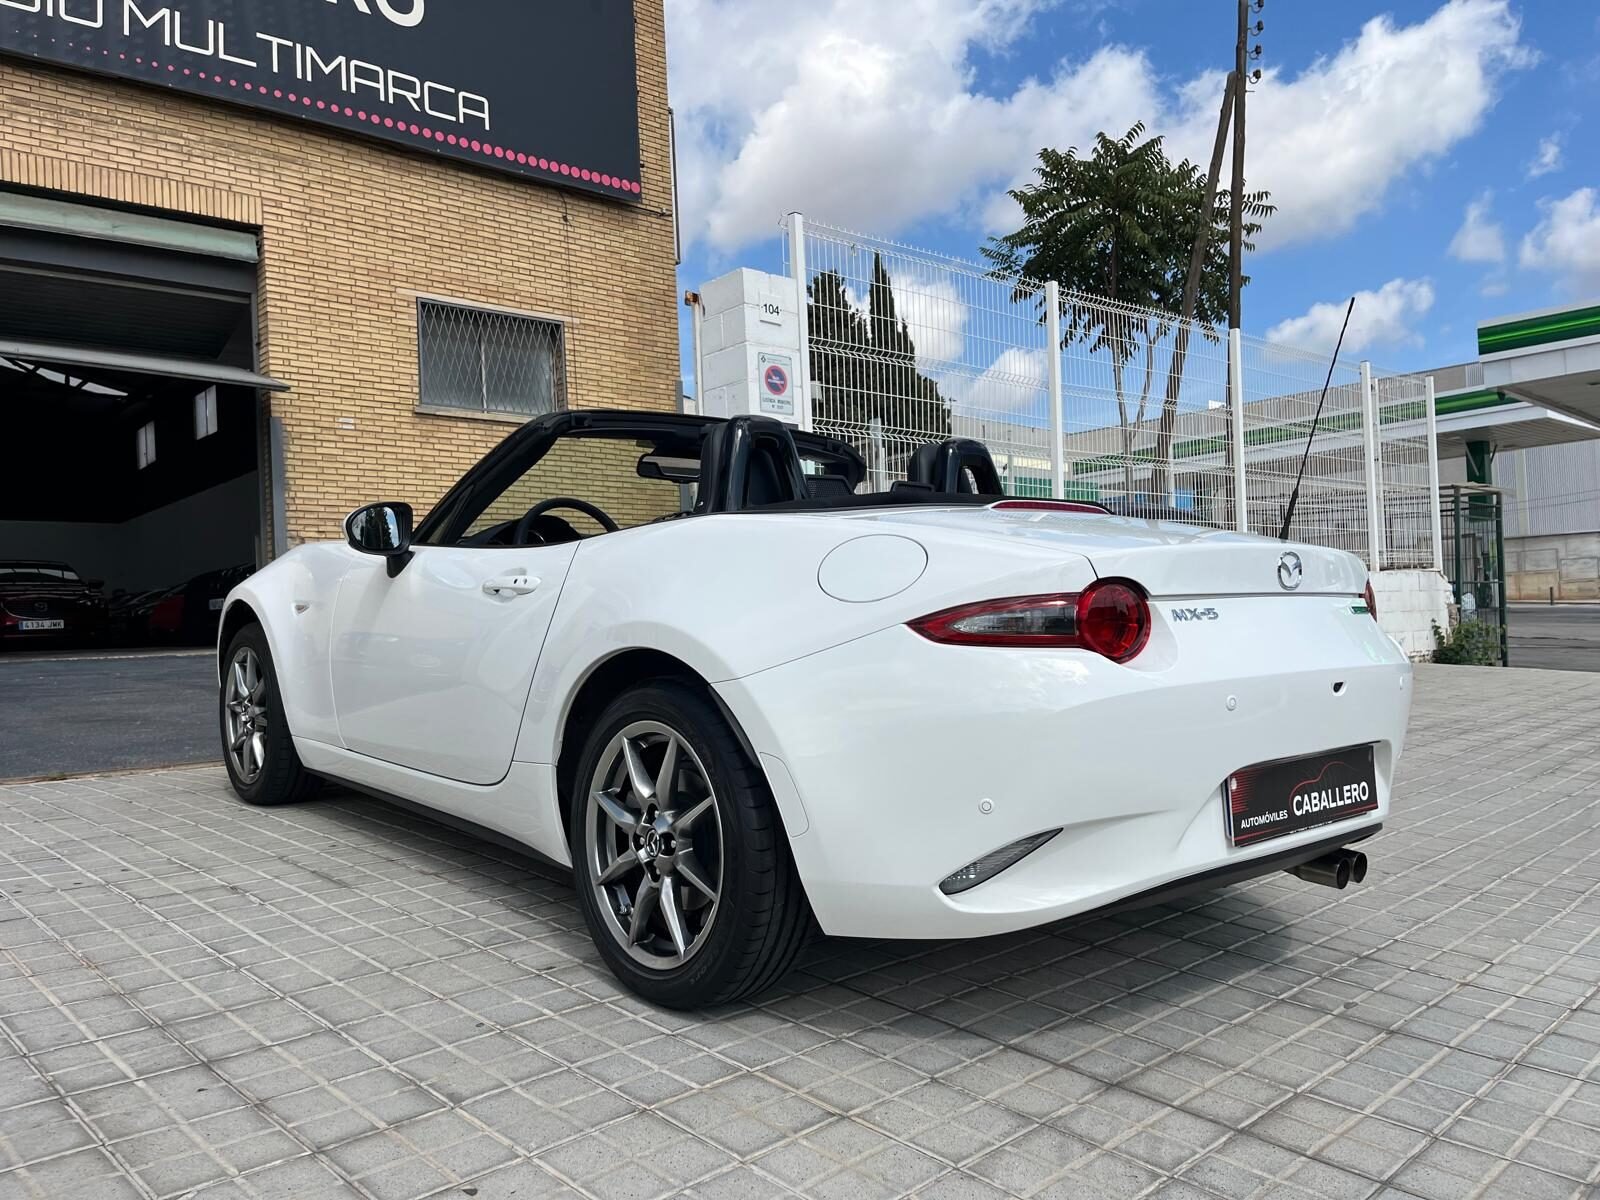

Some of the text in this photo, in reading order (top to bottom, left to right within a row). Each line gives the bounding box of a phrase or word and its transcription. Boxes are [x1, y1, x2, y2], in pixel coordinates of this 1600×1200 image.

[123, 0, 490, 131] MULTIMARCA
[763, 304, 780, 316] 104
[1171, 607, 1219, 622] MX-5
[1241, 810, 1288, 828] AUTOMÓVILES
[1293, 781, 1369, 815] CABALLERO
